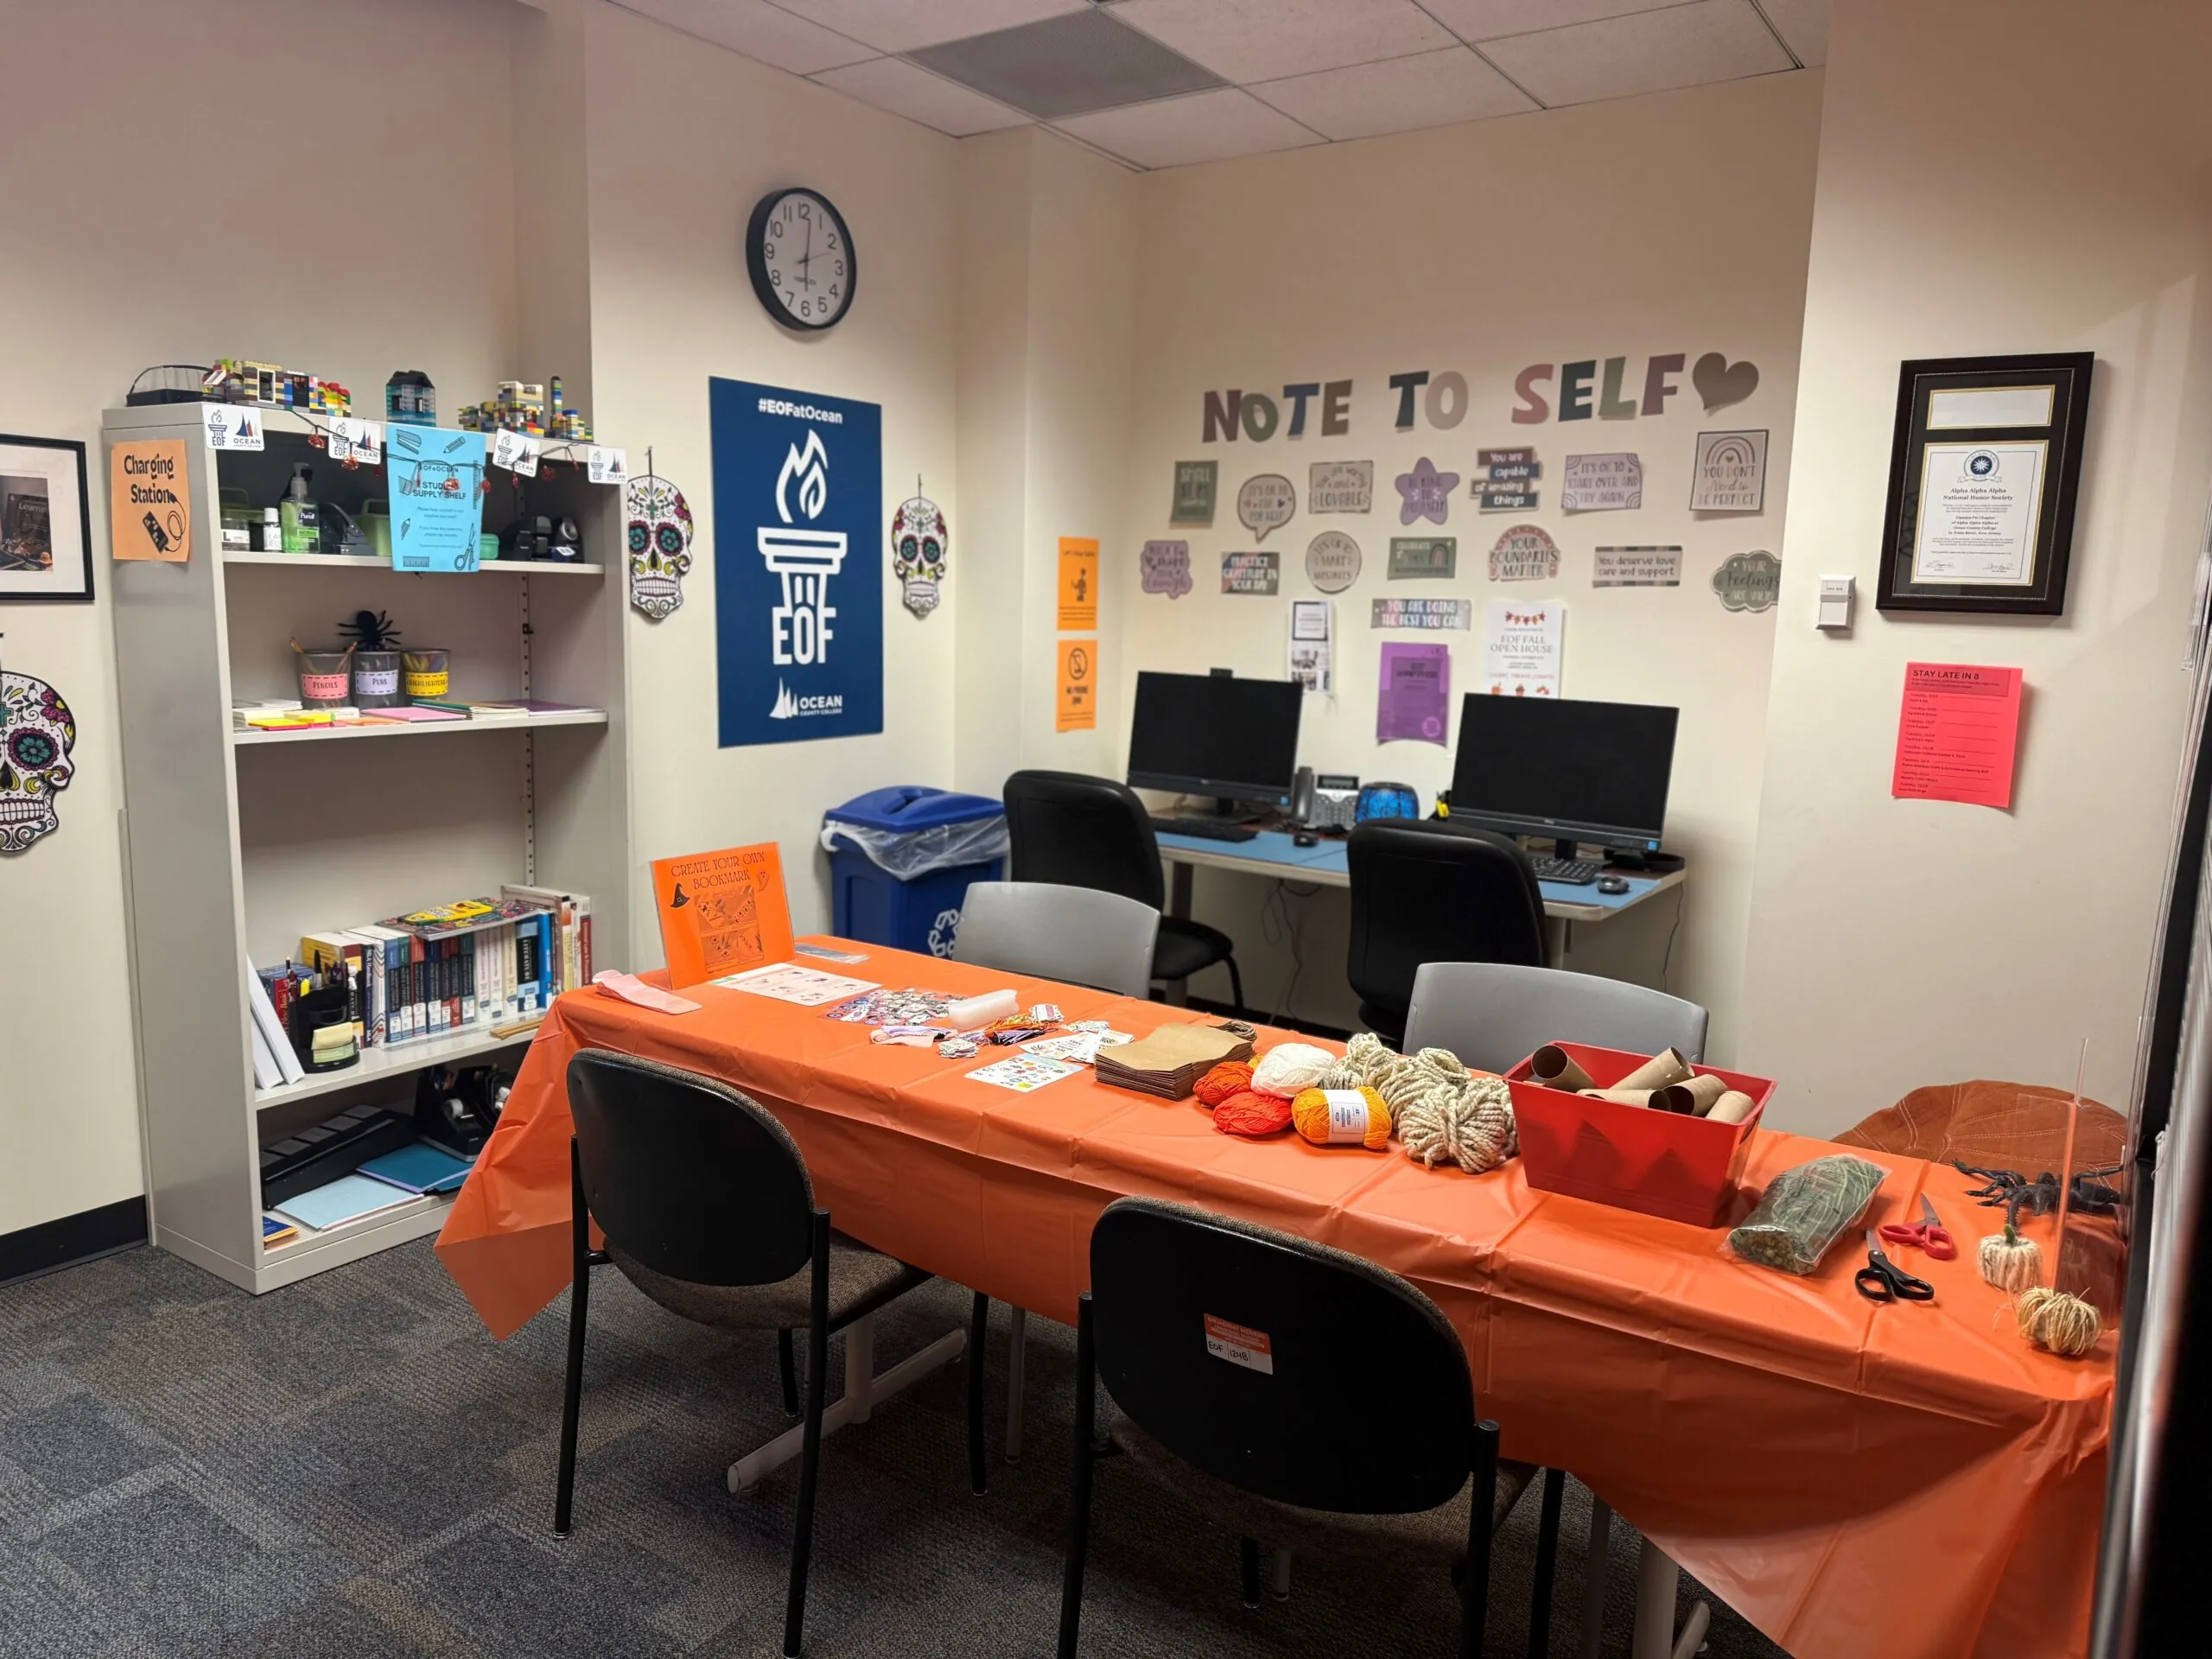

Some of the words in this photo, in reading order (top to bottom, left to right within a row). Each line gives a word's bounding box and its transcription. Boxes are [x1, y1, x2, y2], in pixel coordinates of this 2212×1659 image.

[783, 204, 792, 222] 11
[798, 201, 810, 220] 12
[818, 213, 823, 230] 1
[770, 219, 783, 238] 10
[827, 232, 836, 250] 2
[765, 242, 775, 260] 9
[834, 259, 843, 276] 3
[771, 269, 781, 286] 8
[829, 283, 839, 299] 4
[785, 290, 795, 308] 7
[817, 296, 828, 313] 5
[800, 300, 810, 317] 6
[1202, 378, 1353, 443] NOTE
[1389, 370, 1469, 430] TO
[1510, 352, 1687, 424] SELF
[758, 397, 843, 424] #EOFatOcean
[212, 435, 226, 447] EOF
[232, 436, 262, 445] OCEAN
[334, 446, 346, 457] EOF
[353, 449, 378, 459] OCEAN
[1490, 452, 1507, 463] You
[1508, 453, 1524, 462] are
[124, 453, 175, 480] Charging
[497, 455, 510, 466] EOF
[513, 460, 535, 473] OCEAN
[1495, 465, 1529, 480] capable
[1580, 462, 1597, 474] IT'S
[1613, 461, 1624, 473] TO
[1703, 466, 1725, 478] YOU
[1726, 465, 1757, 478] DON'T
[1474, 482, 1485, 493] of
[1487, 481, 1524, 493] amazing
[1567, 477, 1592, 489] START
[1595, 476, 1618, 488] OVER
[1620, 475, 1639, 487] AND
[130, 482, 170, 505] Station
[412, 490, 442, 499] SUPPLY
[443, 491, 467, 500] SHELF
[1712, 493, 1757, 505] PERFECT
[1319, 493, 1363, 508] LOVABLE
[1493, 495, 1525, 507] things
[1510, 537, 1538, 550] YOUR
[1489, 550, 1560, 563] BOUNDARIES
[1599, 556, 1614, 565] You
[1616, 556, 1654, 566] deserve
[1501, 563, 1544, 577] MATTER
[1598, 567, 1617, 576] care
[1618, 566, 1636, 576] and
[1637, 566, 1675, 578] support
[1742, 560, 1766, 572] YOUR
[1387, 600, 1407, 613] YOU
[1424, 601, 1457, 613] DOING
[1382, 613, 1398, 625] THE
[1399, 613, 1421, 626] BEST
[1422, 614, 1441, 626] YOU
[772, 605, 836, 665] EOF
[1501, 635, 1521, 644] EOF
[1522, 635, 1546, 645] FALL
[1490, 643, 1519, 652] OPEN
[1521, 644, 1554, 653] HOUSE
[1913, 669, 1936, 678] STAY
[1937, 671, 1961, 679] LATE
[1961, 671, 1972, 680] IN
[312, 680, 339, 690] PENCILS
[372, 677, 388, 686] PENS
[799, 694, 843, 709] OCEAN
[670, 860, 710, 878] CREATE
[711, 856, 741, 871] YOUR
[742, 851, 767, 865] OWN
[693, 869, 752, 890] BOOKMARK
[1208, 1340, 1224, 1352] EOF
